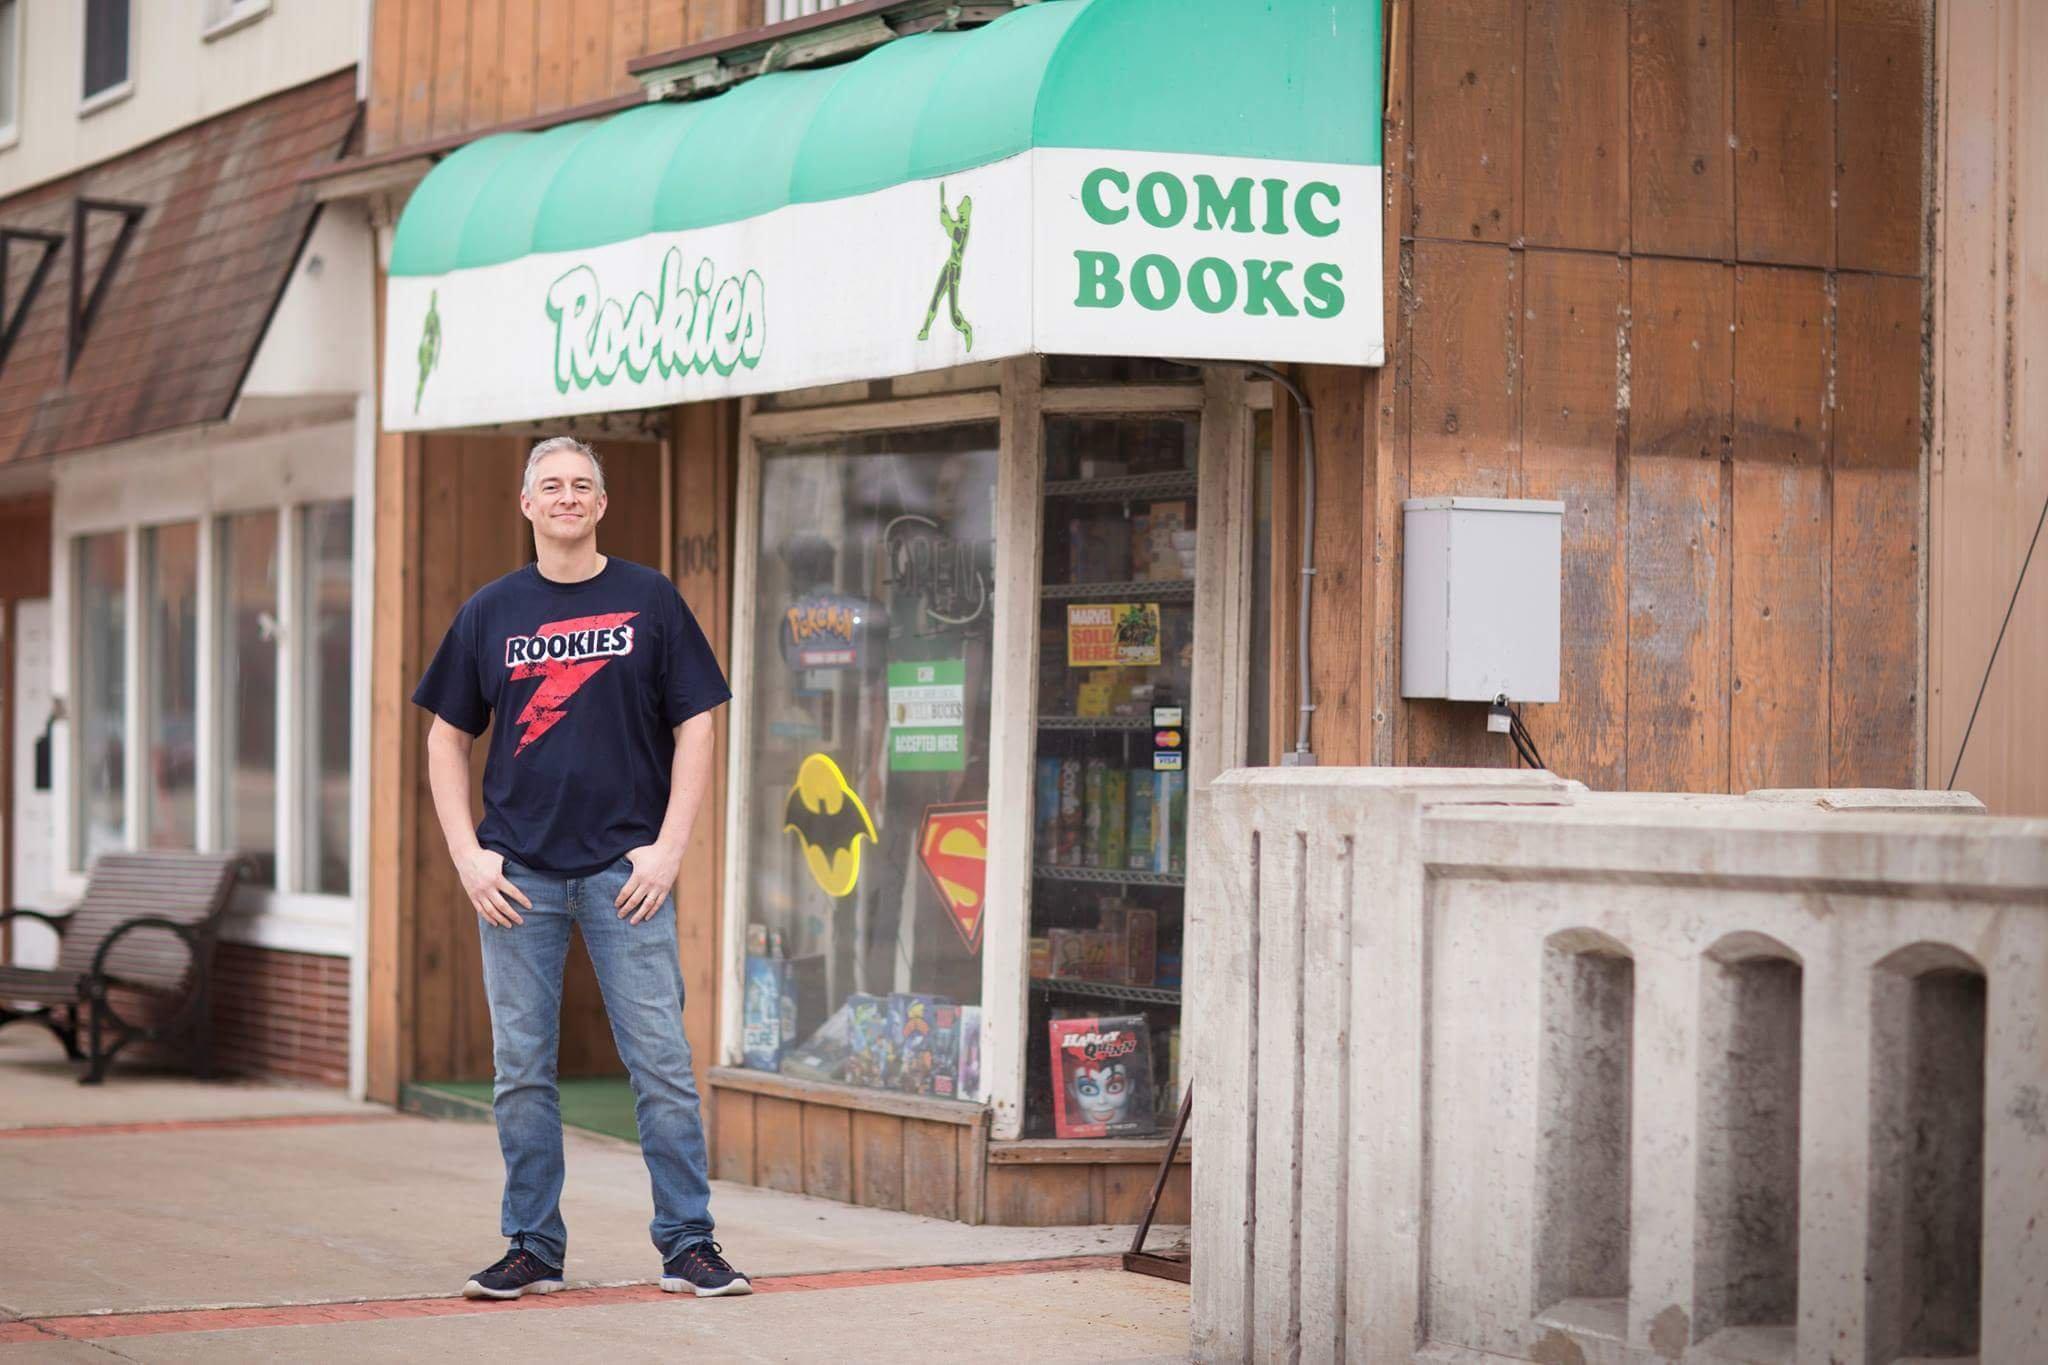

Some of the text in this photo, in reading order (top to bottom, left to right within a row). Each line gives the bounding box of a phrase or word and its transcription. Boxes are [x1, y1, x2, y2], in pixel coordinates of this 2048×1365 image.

[1081, 167, 1341, 237] COMIC
[1073, 250, 1346, 319] BOOKS
[546, 245, 766, 395] Rookies
[1071, 607, 1113, 625] MARVEL
[505, 624, 632, 667] ROOKIES
[1072, 628, 1113, 644] SOLD
[1072, 646, 1113, 661] HERE
[895, 734, 959, 753] ACCEPTED HERE
[1062, 1031, 1121, 1048] HARLEY
[1083, 1039, 1137, 1060] QUINN
